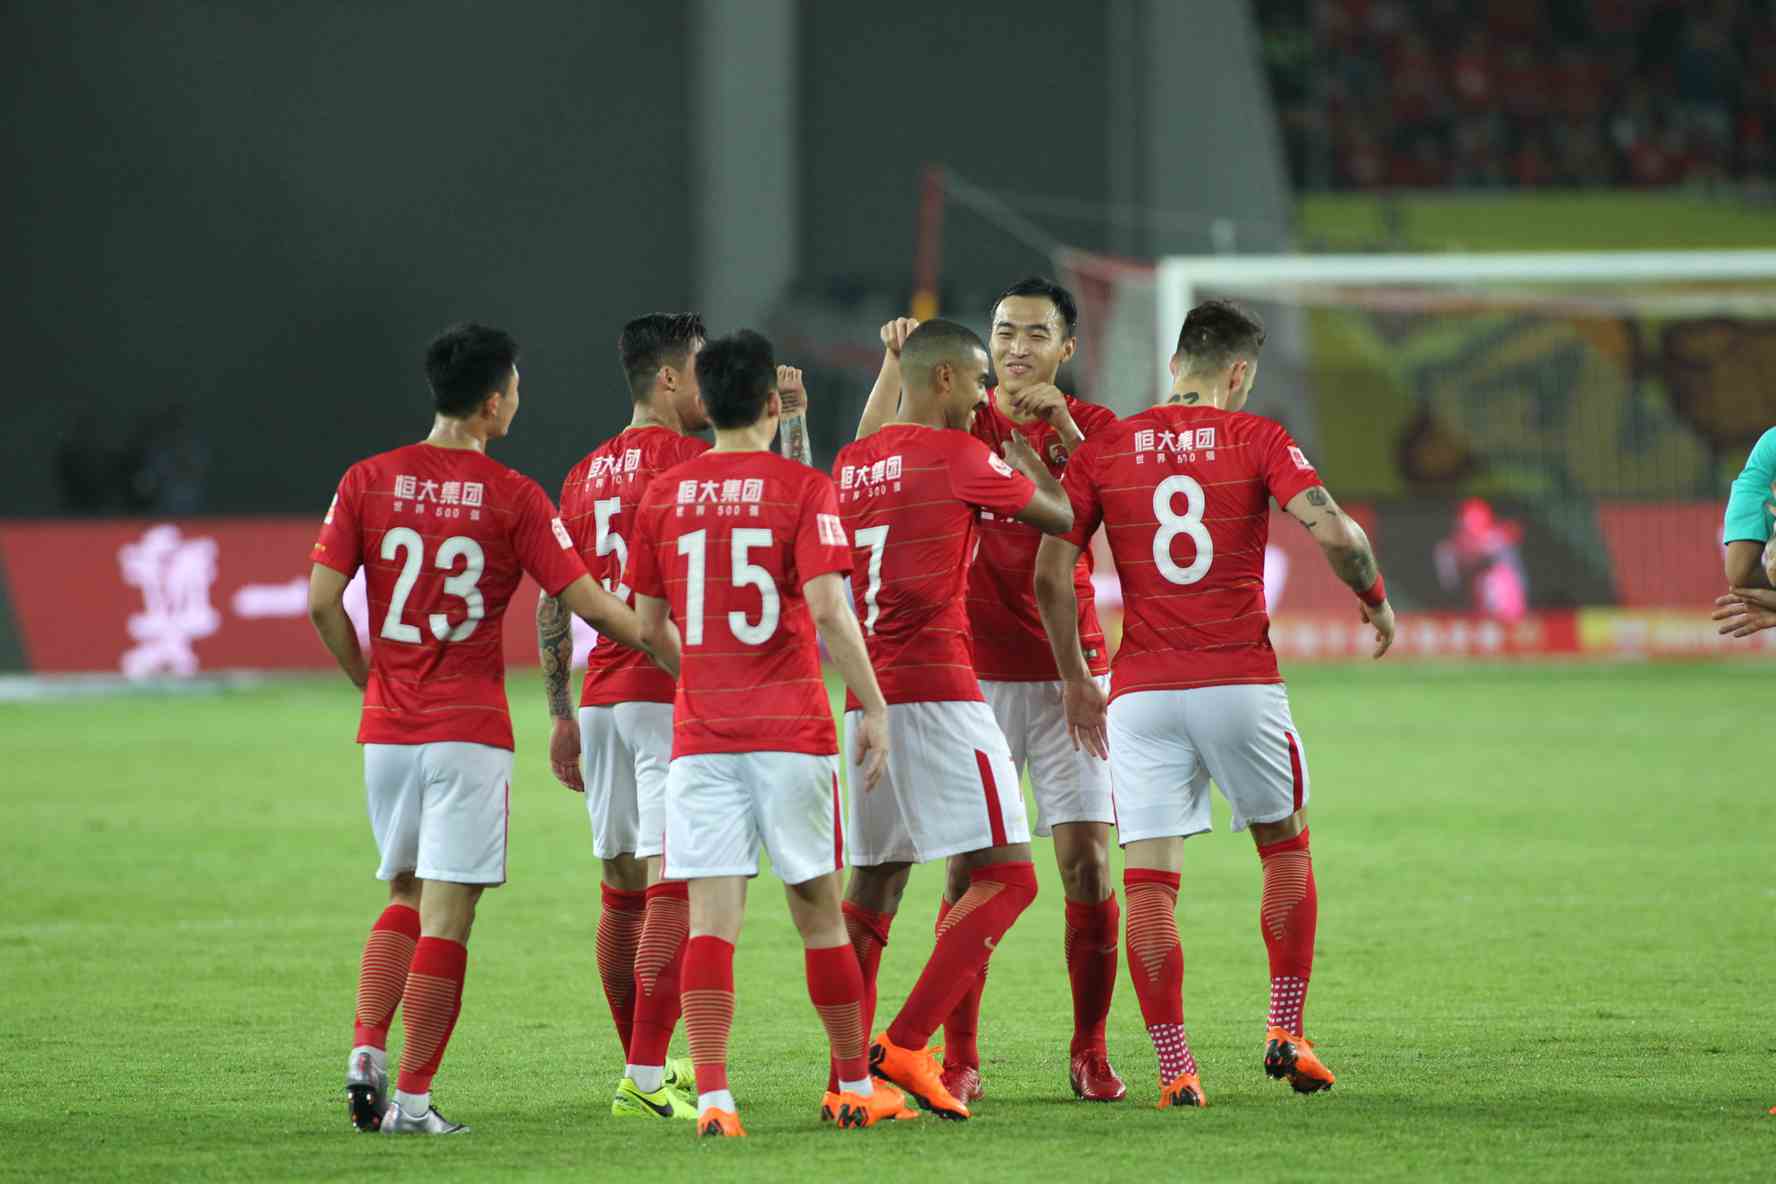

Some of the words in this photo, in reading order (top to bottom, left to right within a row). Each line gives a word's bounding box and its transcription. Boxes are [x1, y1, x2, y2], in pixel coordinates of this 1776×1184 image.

[394, 474, 485, 507] 恒大集团
[677, 478, 764, 504] 恒大集团
[841, 455, 903, 490] 恒大集团
[1135, 427, 1216, 453] 恒大集团
[593, 496, 632, 603] 5
[855, 525, 890, 636] 7
[1153, 474, 1214, 585] 8
[381, 526, 485, 644] 23
[677, 528, 780, 646] 15
